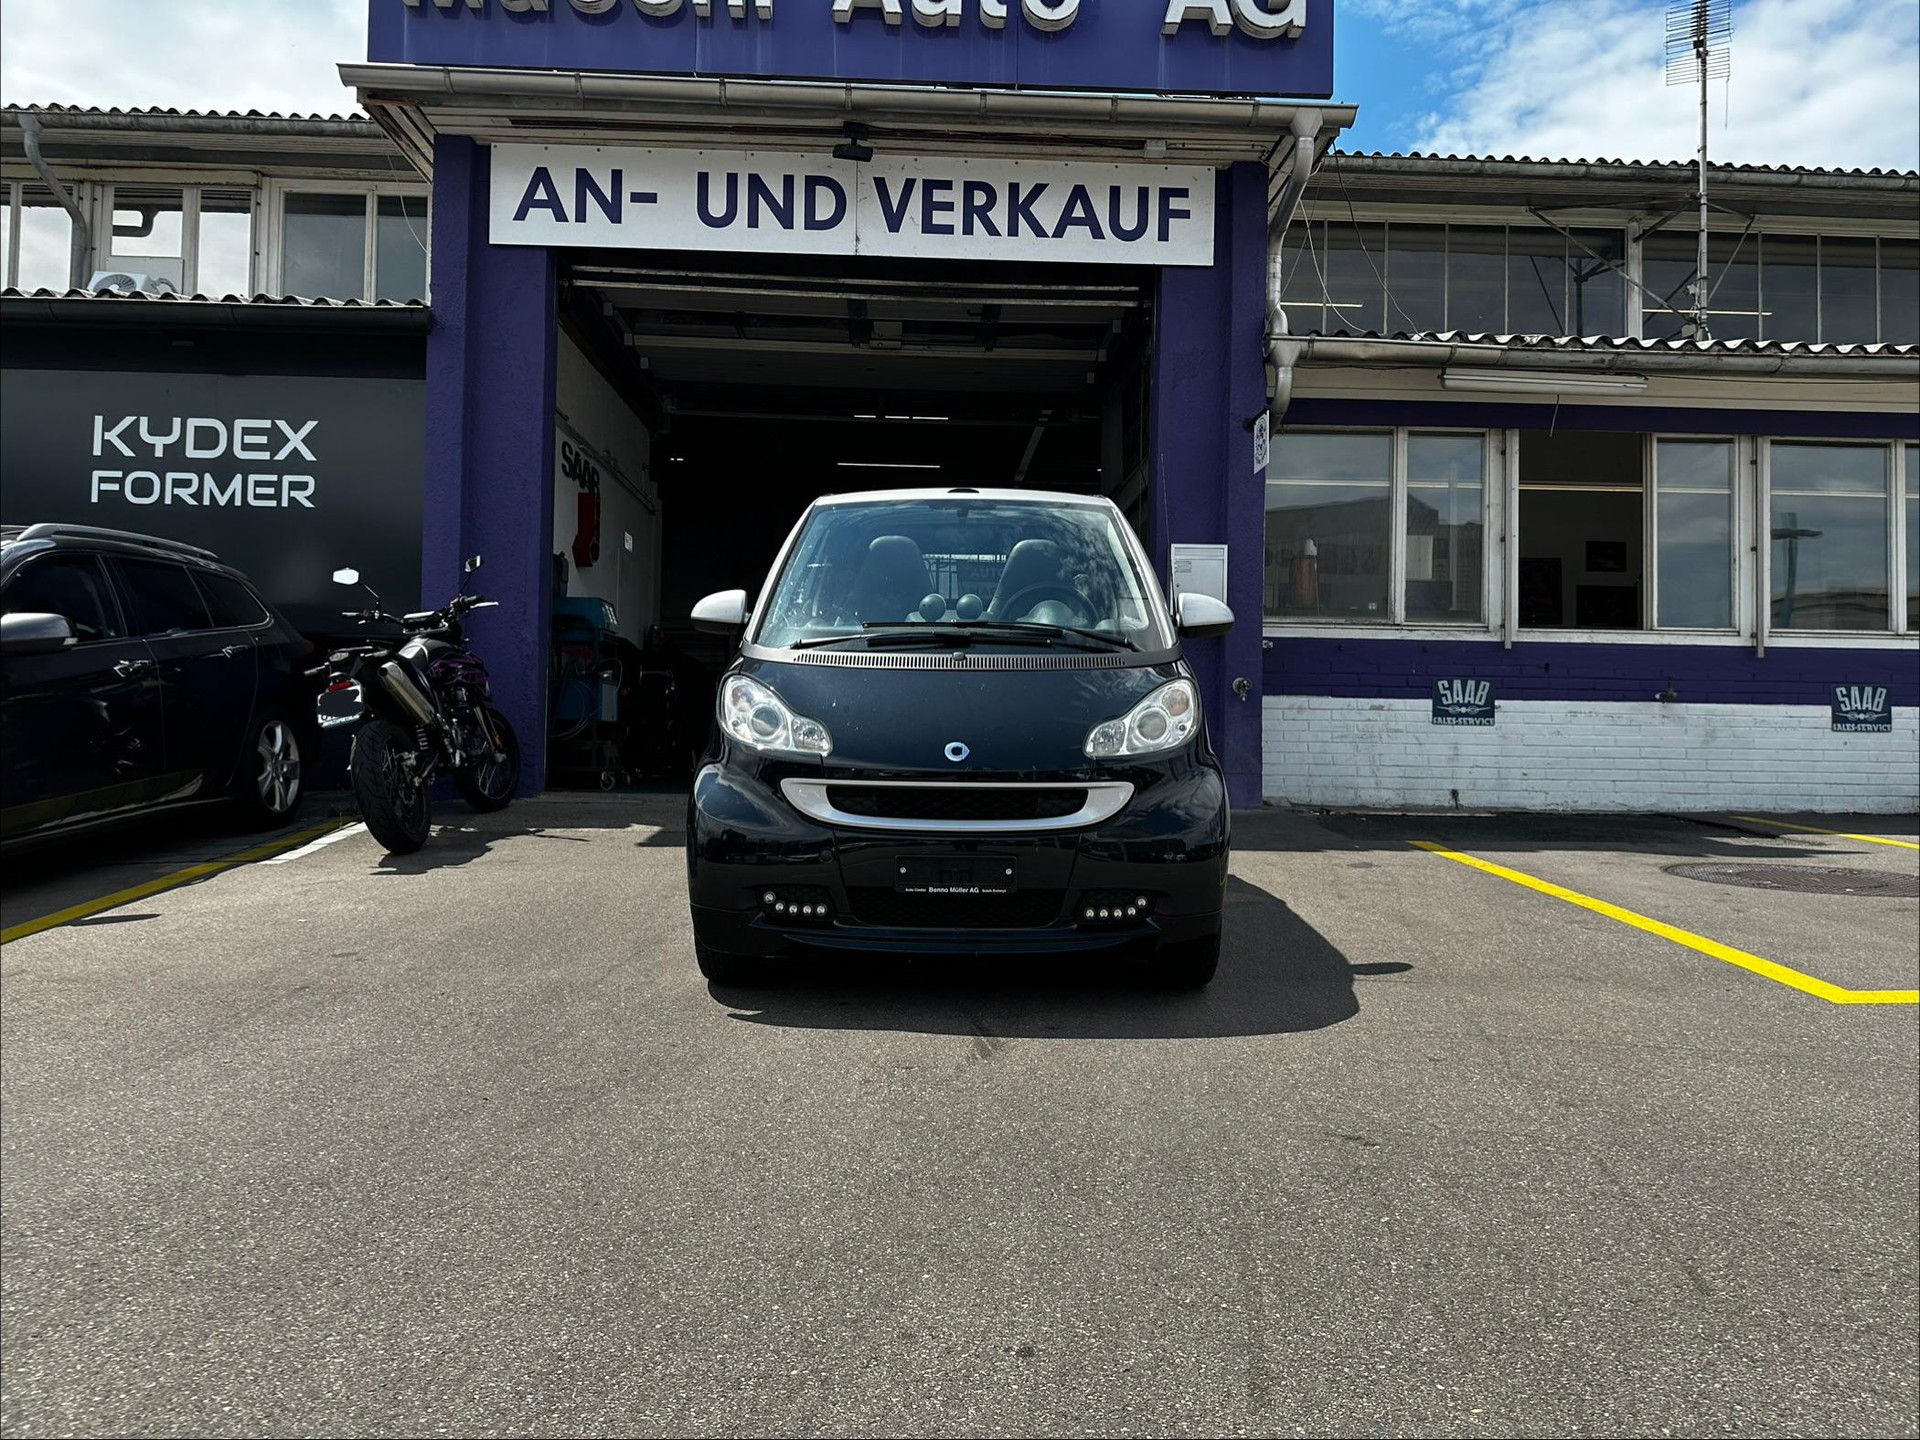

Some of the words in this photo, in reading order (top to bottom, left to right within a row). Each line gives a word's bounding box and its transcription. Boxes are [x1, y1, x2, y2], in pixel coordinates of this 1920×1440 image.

[512, 166, 658, 225] AN-
[696, 171, 848, 231] UND
[872, 176, 1191, 242] VERKAUF
[92, 415, 319, 461] KYDEX
[90, 470, 316, 508] FORMER
[1437, 679, 1490, 705] SAAB
[1835, 686, 1887, 712] SAAB
